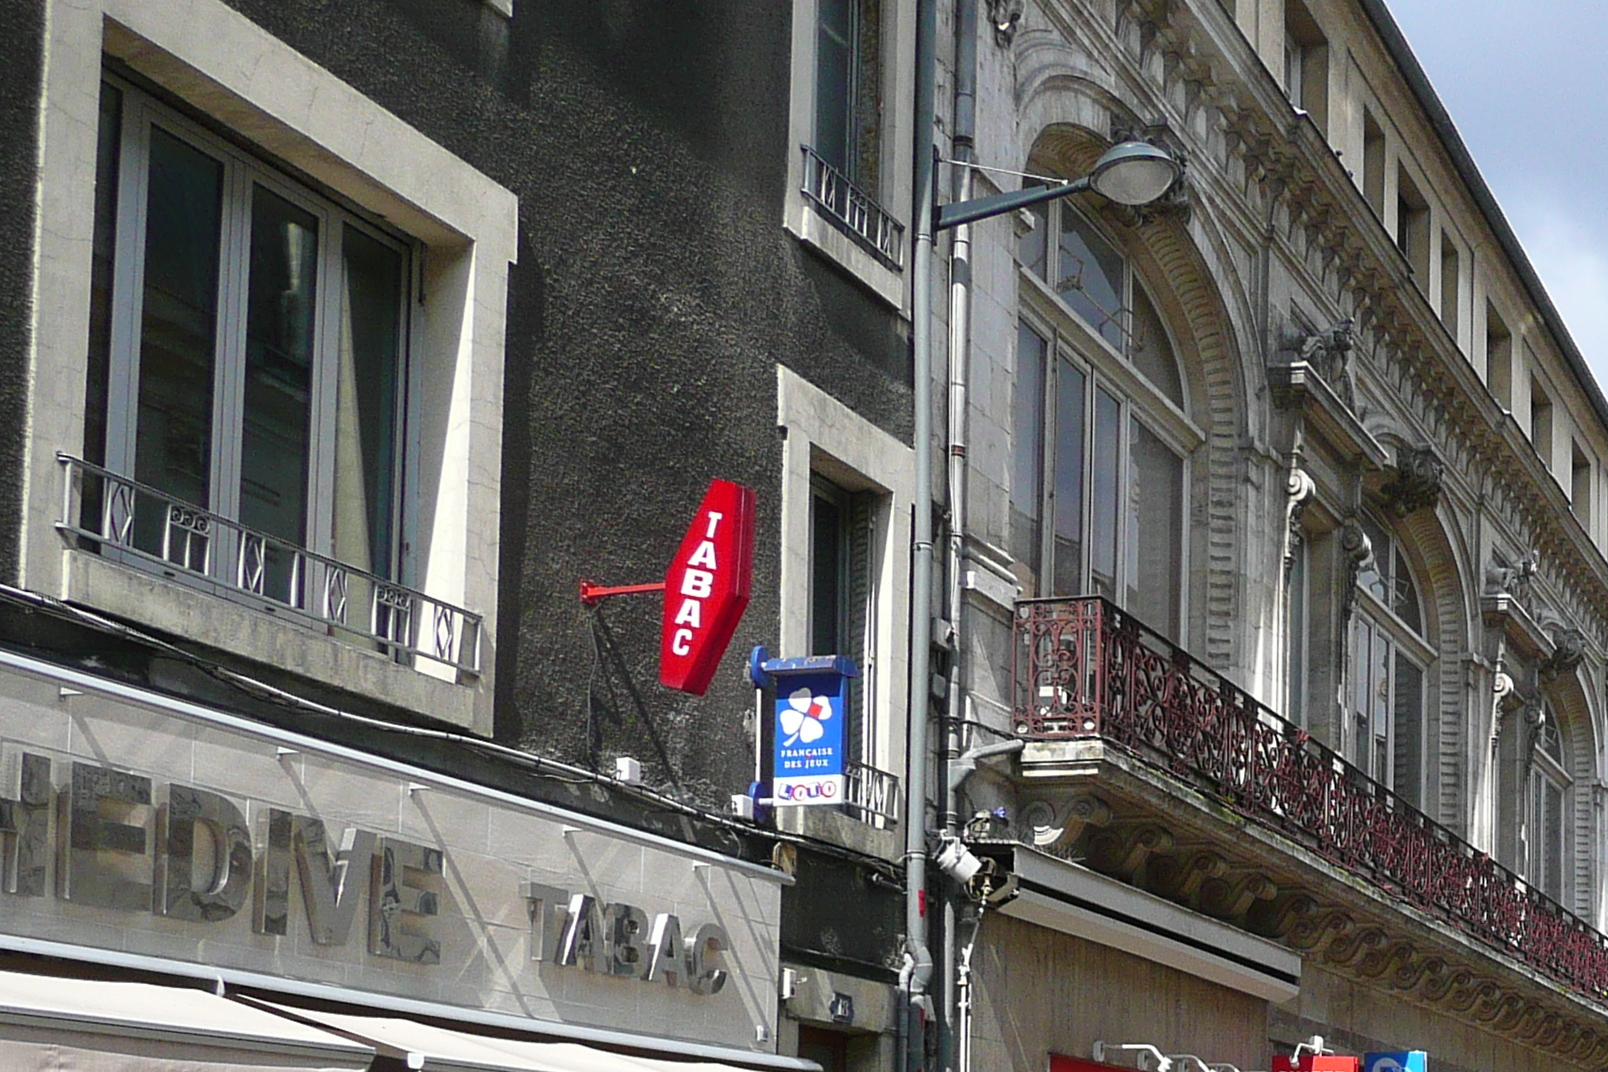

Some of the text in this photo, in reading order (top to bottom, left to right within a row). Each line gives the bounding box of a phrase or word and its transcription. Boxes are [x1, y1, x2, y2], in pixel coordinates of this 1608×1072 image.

[672, 511, 723, 656] TABAC
[778, 780, 837, 801] LOTO
[805, 759, 829, 769] JEUX
[518, 880, 729, 996] TABAC
